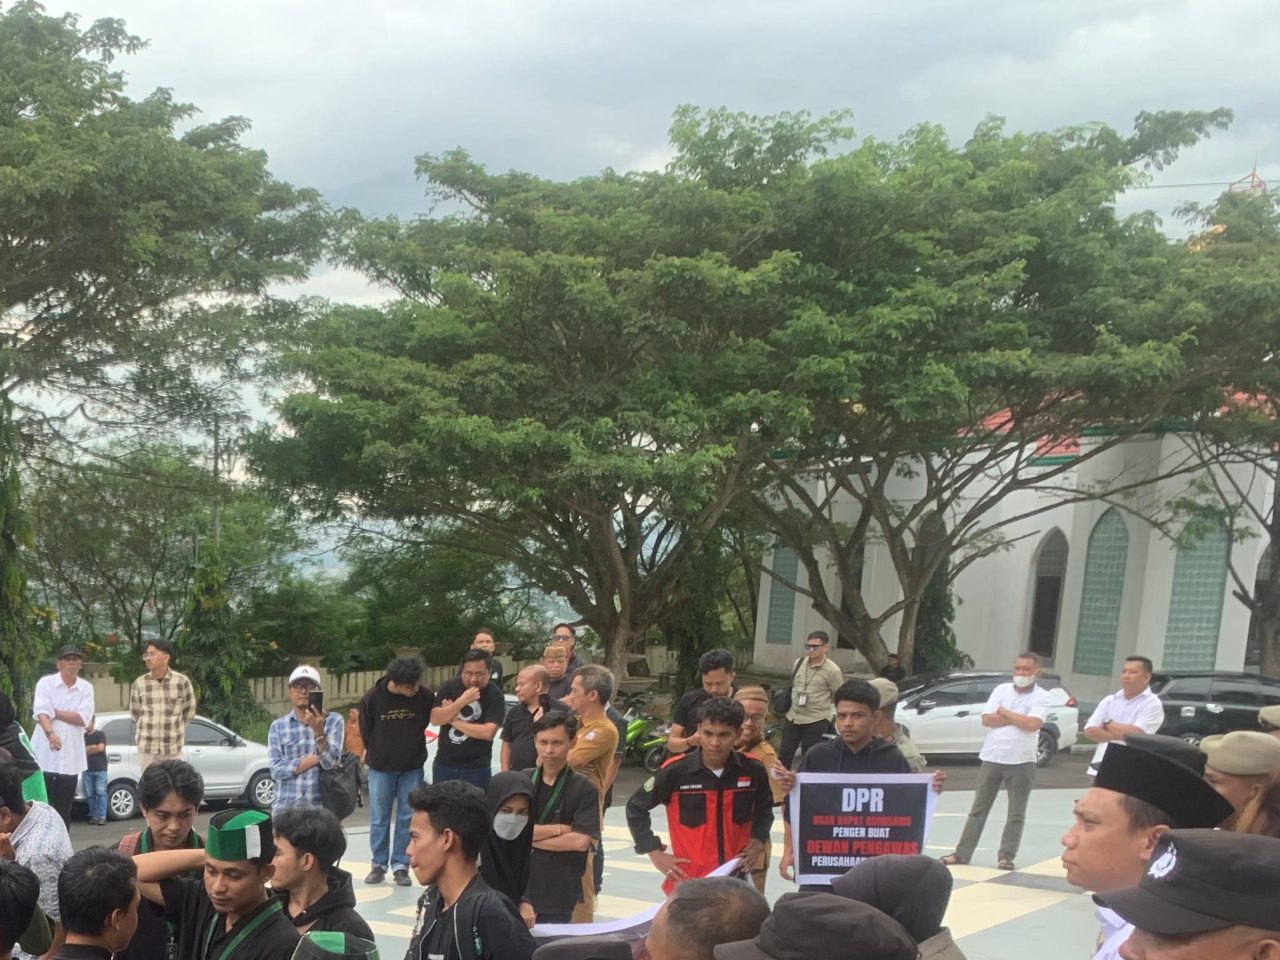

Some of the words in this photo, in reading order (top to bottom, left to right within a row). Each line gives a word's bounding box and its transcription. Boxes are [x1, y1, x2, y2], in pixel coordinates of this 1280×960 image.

[841, 788, 885, 812] DPR
[832, 827, 866, 838] PENGEN
[868, 827, 891, 839] BUAT
[806, 840, 849, 854] DEWAN
[852, 841, 918, 856] PENGAWAS
[811, 856, 866, 867] PERUSAHAA
